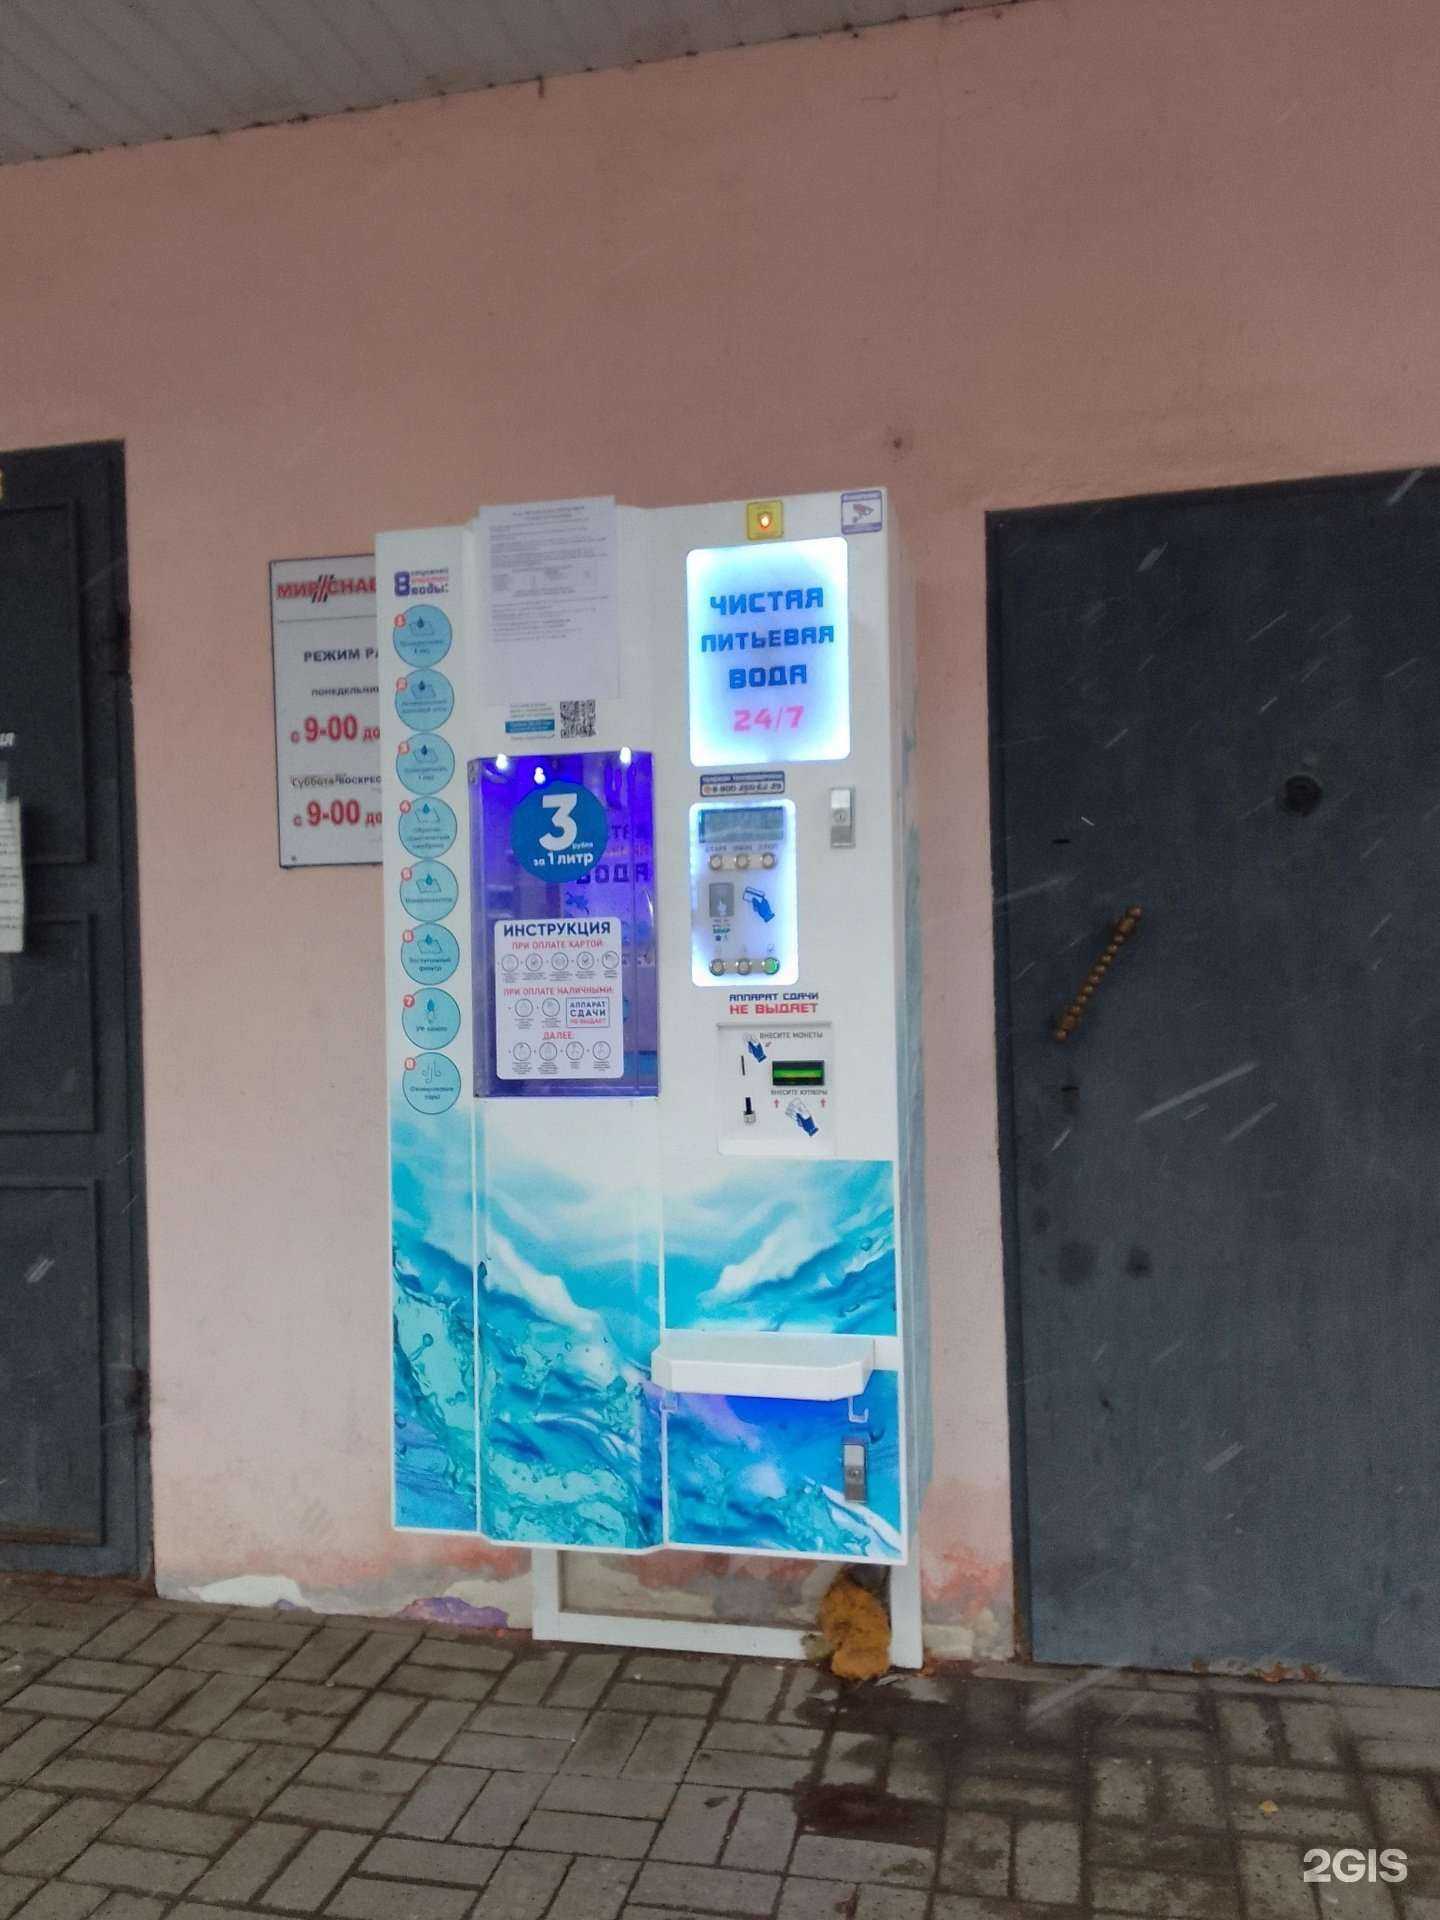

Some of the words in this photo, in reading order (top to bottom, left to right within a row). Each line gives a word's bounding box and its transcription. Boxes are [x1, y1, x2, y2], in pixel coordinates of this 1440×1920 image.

[394, 571, 410, 596] 8
[710, 587, 824, 615] ЧИСТАЯ
[701, 625, 834, 652] ПИТЬЕВАЯ
[304, 648, 360, 662] РЕЖИМ
[729, 664, 807, 689] ВОДА
[733, 705, 804, 732] 24/7
[304, 714, 358, 742] 9-00
[363, 726, 381, 742] до
[307, 799, 360, 826] 9-00
[365, 811, 383, 827] до
[539, 793, 577, 851] 3
[533, 858, 545, 867] за
[547, 852, 554, 865] 1
[557, 852, 594, 866] литр
[504, 921, 611, 937] ИНСТРУКЦИЯ
[512, 941, 530, 951] ПРИ
[532, 939, 566, 950] ОПЛАТЕ
[504, 987, 520, 997] ПРИ
[522, 986, 554, 996] ОПЛАТЕ
[729, 993, 779, 1002] АППАРАТ
[783, 992, 819, 1001] СДАЧИ
[570, 1001, 605, 1009] АППАРАТ
[730, 1004, 748, 1015] НЕ
[755, 1003, 818, 1015] ВЫДАЕТ
[570, 1009, 606, 1018] СДАЧИ
[792, 1031, 823, 1039] МОНЕТЫ
